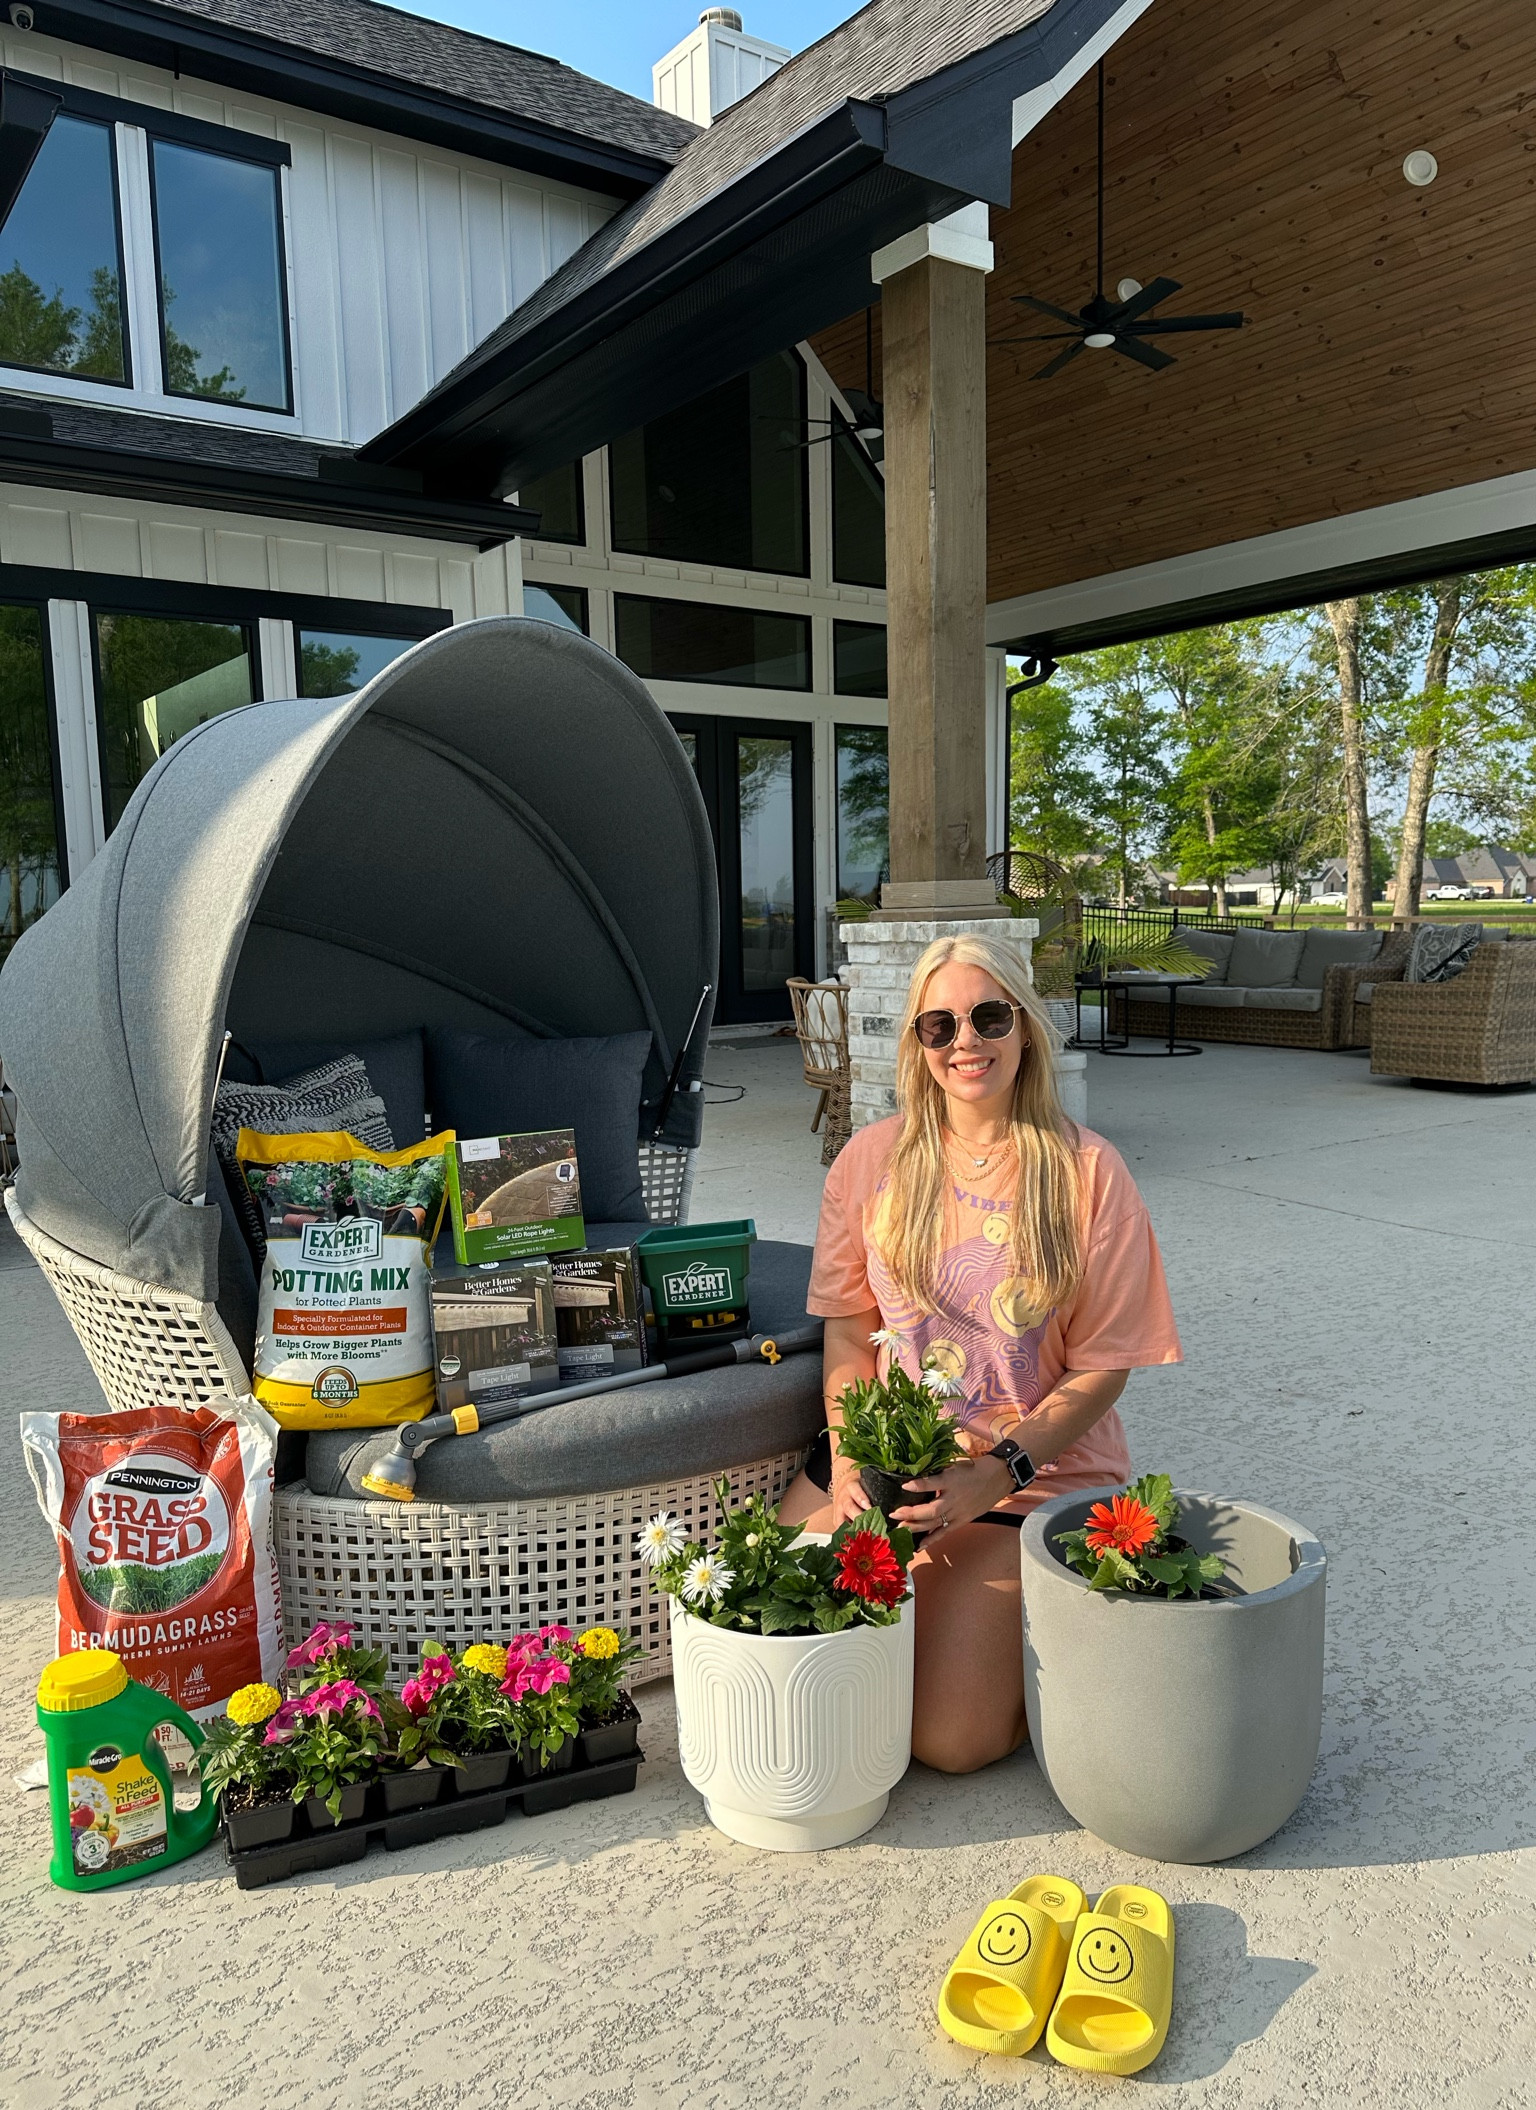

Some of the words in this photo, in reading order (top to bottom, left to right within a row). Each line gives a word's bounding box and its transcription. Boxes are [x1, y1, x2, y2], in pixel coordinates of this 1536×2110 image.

[309, 1225, 373, 1248] EXPERT
[538, 1227, 555, 1236] Lights
[574, 1260, 603, 1270] Homes
[272, 1269, 363, 1294] POTTING
[370, 1267, 411, 1291] MIX
[464, 1280, 491, 1291] Better
[492, 1276, 522, 1287] Homes
[668, 1273, 726, 1294] EXPERT
[296, 1297, 309, 1306] for
[312, 1297, 346, 1307] Potted
[349, 1296, 382, 1306] Plants
[292, 1315, 326, 1324] Specially
[327, 1313, 371, 1322] Formulated
[372, 1313, 383, 1321] for
[277, 1322, 298, 1331] Indoor
[306, 1323, 338, 1331] Outdoor
[340, 1323, 377, 1331] Container
[275, 1339, 300, 1350] Helps
[302, 1340, 330, 1349] Grow
[333, 1340, 368, 1350] Bigger
[371, 1338, 402, 1347] Plants
[287, 1351, 308, 1360] with
[311, 1351, 338, 1360] More
[567, 1354, 585, 1362] Tape
[585, 1353, 602, 1361] Light
[481, 1377, 499, 1385] Tape
[500, 1373, 519, 1382] Light
[320, 1390, 358, 1398] MONTHS
[110, 1472, 197, 1490] PENNINGTON
[88, 1492, 207, 1528] GRASS
[87, 1515, 213, 1566] SEED
[70, 1606, 238, 1651] BERMUDAGRASS
[120, 1650, 151, 1661] HERN
[157, 1642, 192, 1655] SUNNY
[198, 1631, 232, 1646] LAWNS
[196, 1685, 211, 1695] DAYS
[88, 1753, 122, 1766] Miracle-Gro
[117, 1775, 154, 1793] Shake
[126, 1782, 158, 1802] Feed
[88, 1844, 97, 1854] 3
